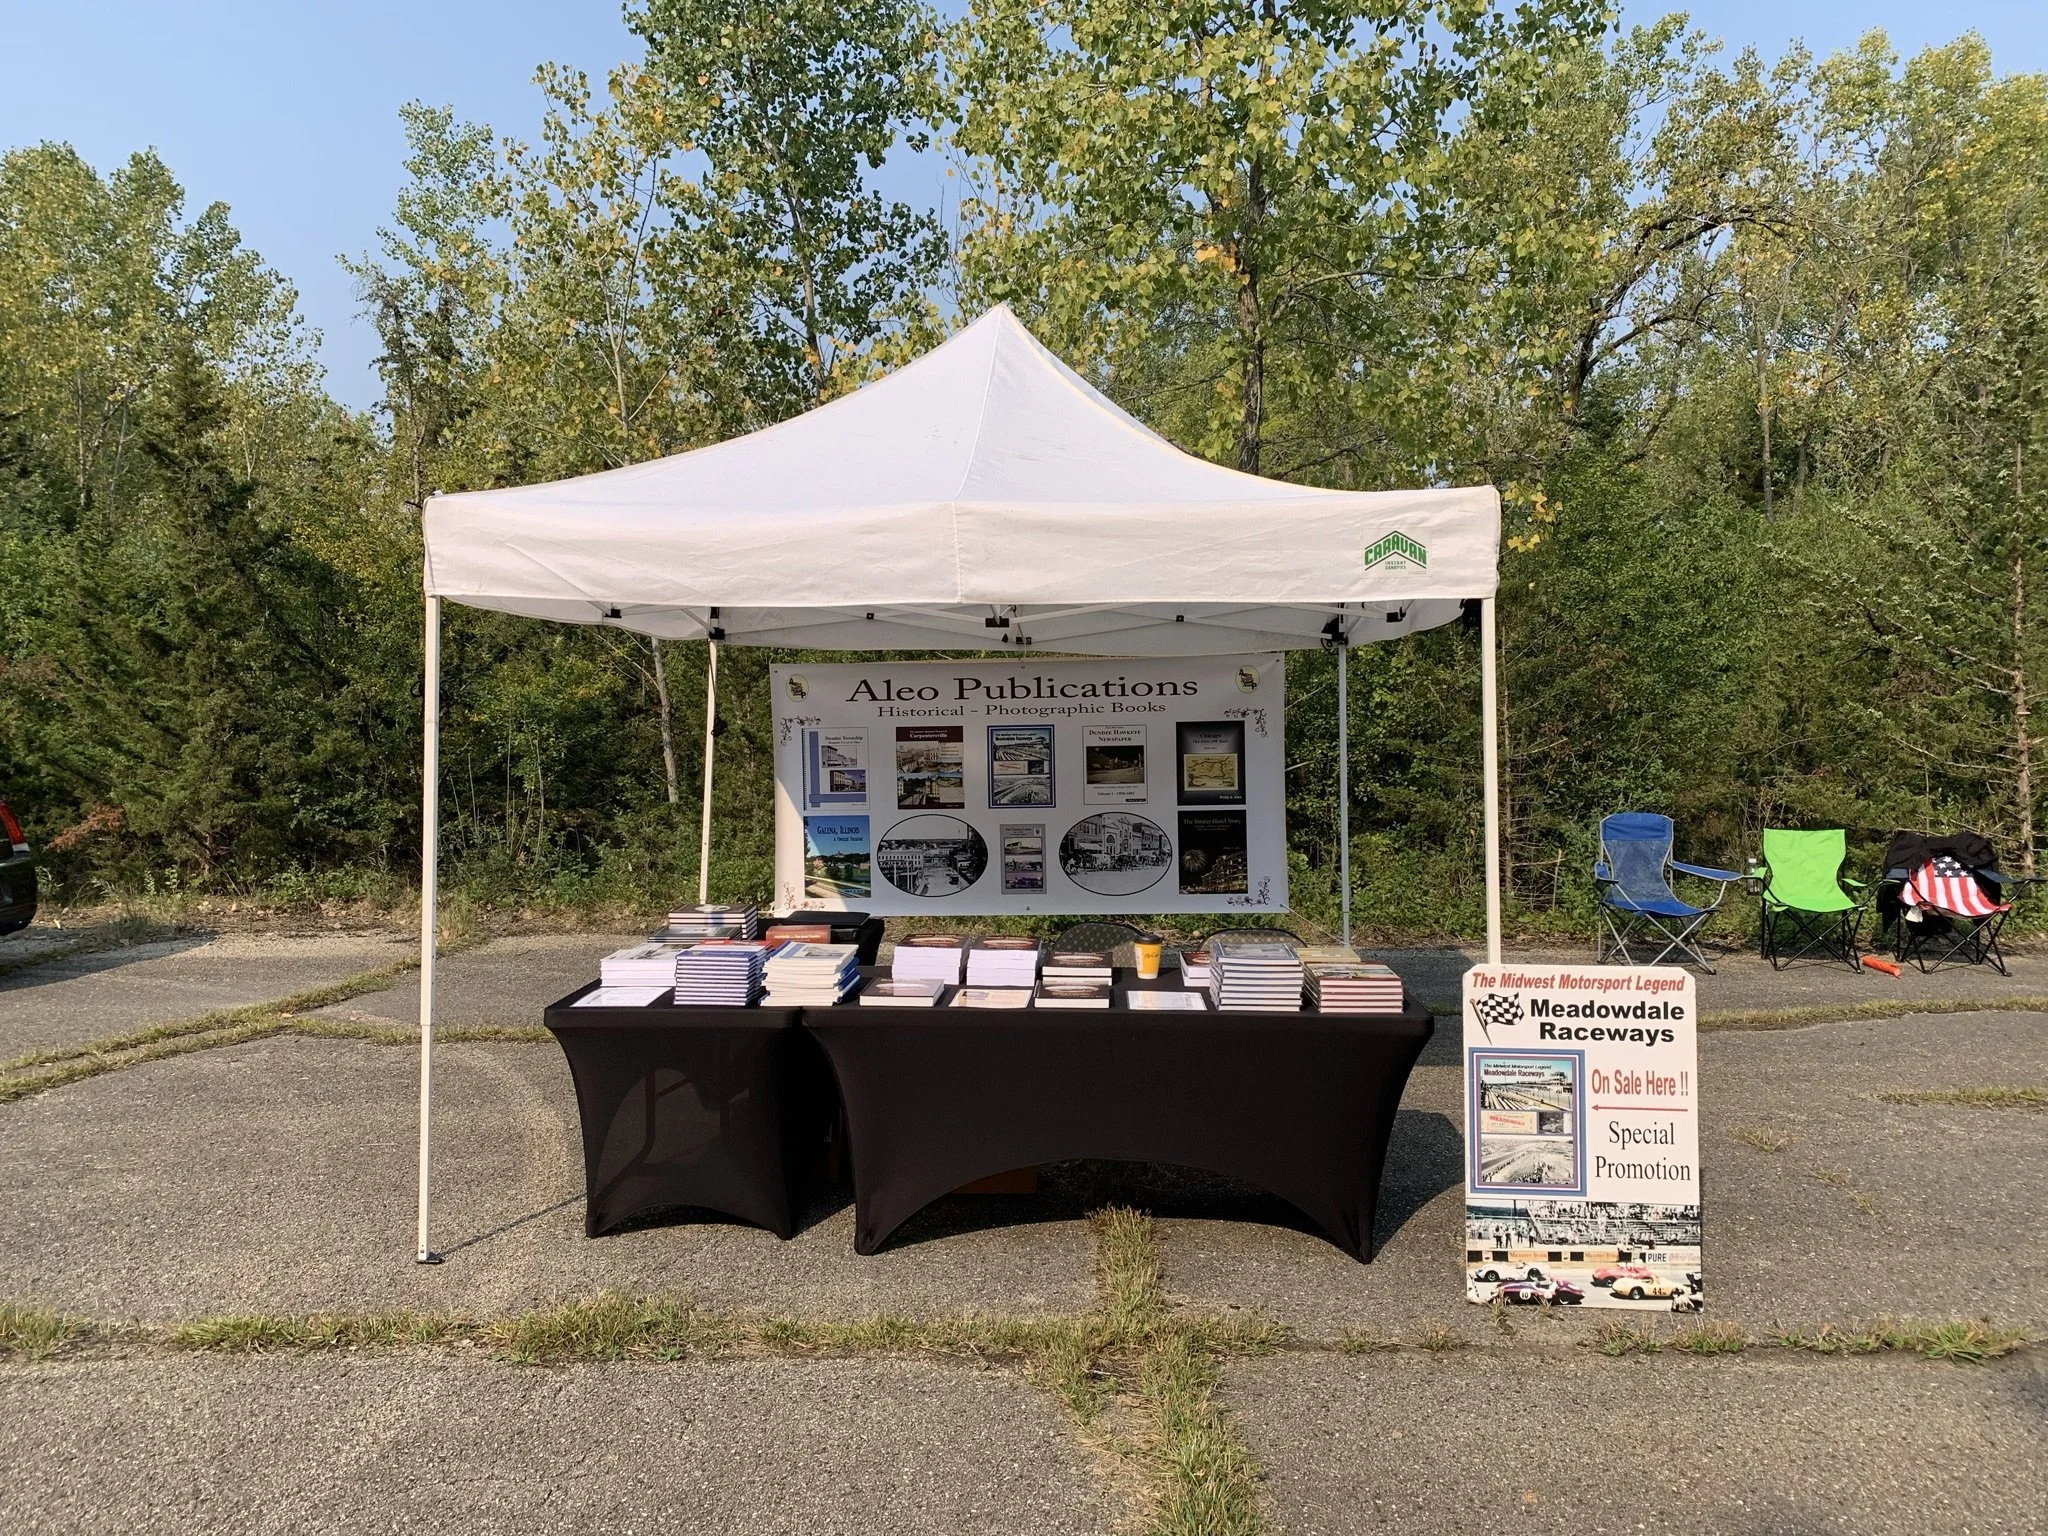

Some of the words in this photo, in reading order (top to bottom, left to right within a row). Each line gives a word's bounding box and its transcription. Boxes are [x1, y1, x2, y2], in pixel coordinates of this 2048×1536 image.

[1364, 534, 1427, 566] CARAVAN
[845, 678, 940, 702] Aleo
[953, 676, 1200, 702] Publications
[878, 705, 965, 718] Historical
[984, 702, 1105, 718] Photographic
[1111, 700, 1167, 714] Books
[817, 825, 838, 836] GALENA,
[840, 825, 860, 835] ILLINOIS
[1472, 972, 1496, 988] The
[1500, 973, 1556, 990] Midwest
[1559, 975, 1632, 993] Motorsport
[1635, 976, 1686, 995] Legend
[1530, 999, 1685, 1020] Meadowdale
[1540, 1022, 1675, 1047] Raceways
[1518, 1069, 1545, 1079] Raceways
[1591, 1069, 1610, 1094] On
[1614, 1069, 1642, 1095] Sale
[1646, 1070, 1677, 1096] Here
[1680, 1071, 1689, 1096] !!
[1608, 1121, 1676, 1150] Special
[1594, 1155, 1692, 1181] Promotion
[1647, 1252, 1667, 1262] PURE
